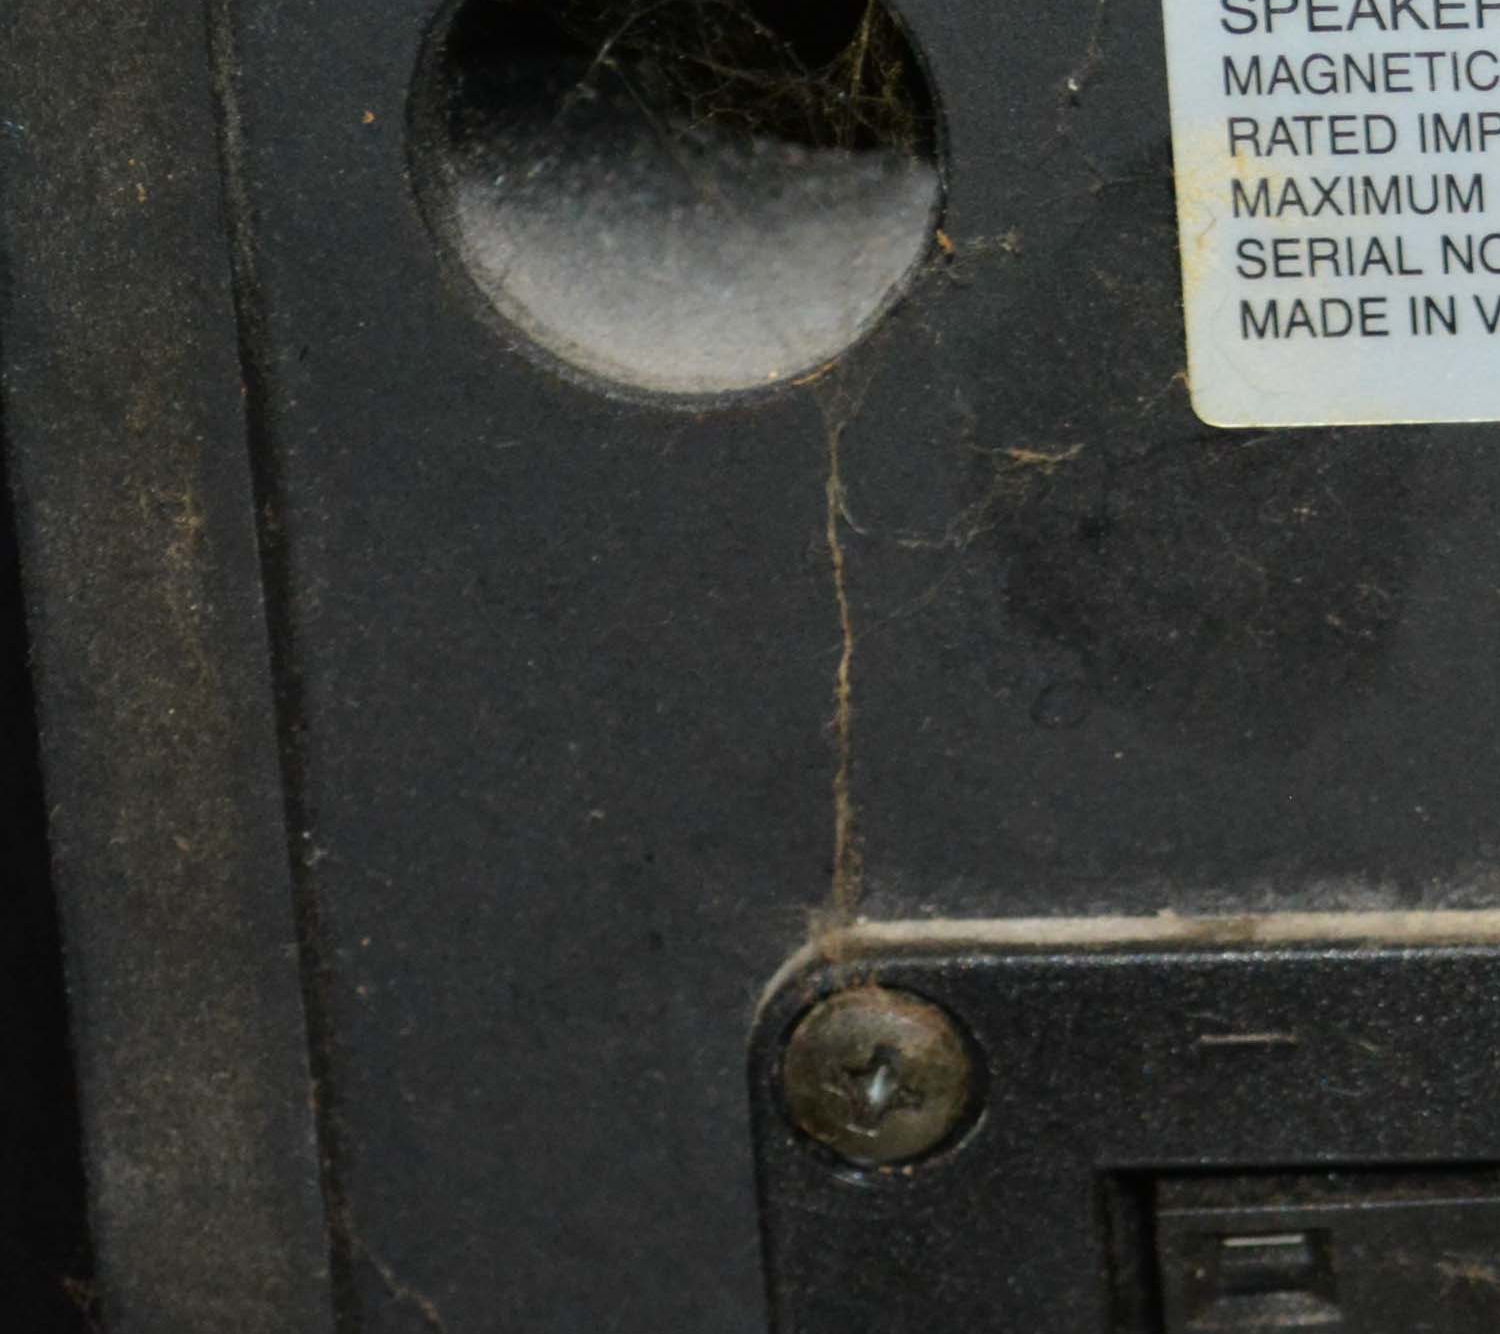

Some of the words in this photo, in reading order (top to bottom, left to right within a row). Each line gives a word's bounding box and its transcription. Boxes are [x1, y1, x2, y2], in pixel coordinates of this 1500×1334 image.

[1227, 114, 1397, 158] RATED
[1231, 173, 1485, 219] MAXIMUM
[1236, 235, 1424, 280] SERIAL
[1240, 296, 1390, 340] MADE
[1409, 295, 1457, 336] IN
